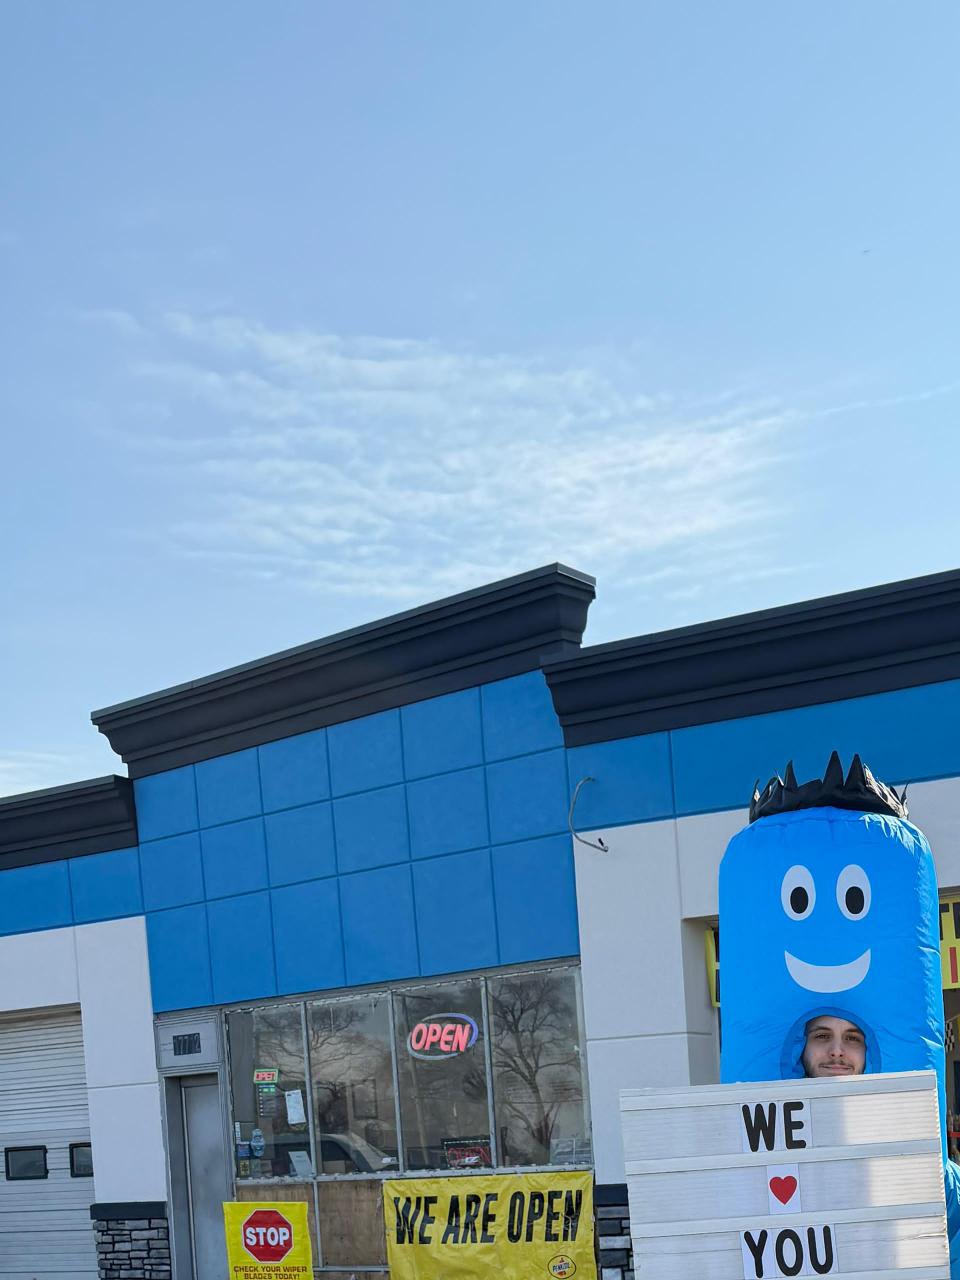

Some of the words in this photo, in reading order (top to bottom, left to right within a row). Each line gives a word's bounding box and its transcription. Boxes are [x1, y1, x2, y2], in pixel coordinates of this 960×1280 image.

[411, 1023, 471, 1052] OPEN
[742, 1101, 807, 1152] WE
[245, 1226, 290, 1246] STOP
[393, 1196, 438, 1245] WE
[441, 1192, 499, 1244] ARE
[507, 1189, 583, 1243] OPEN
[233, 1265, 259, 1273] CHECK
[261, 1265, 281, 1273] YOUR
[283, 1265, 308, 1273] WIPER
[743, 1225, 834, 1279] YOU
